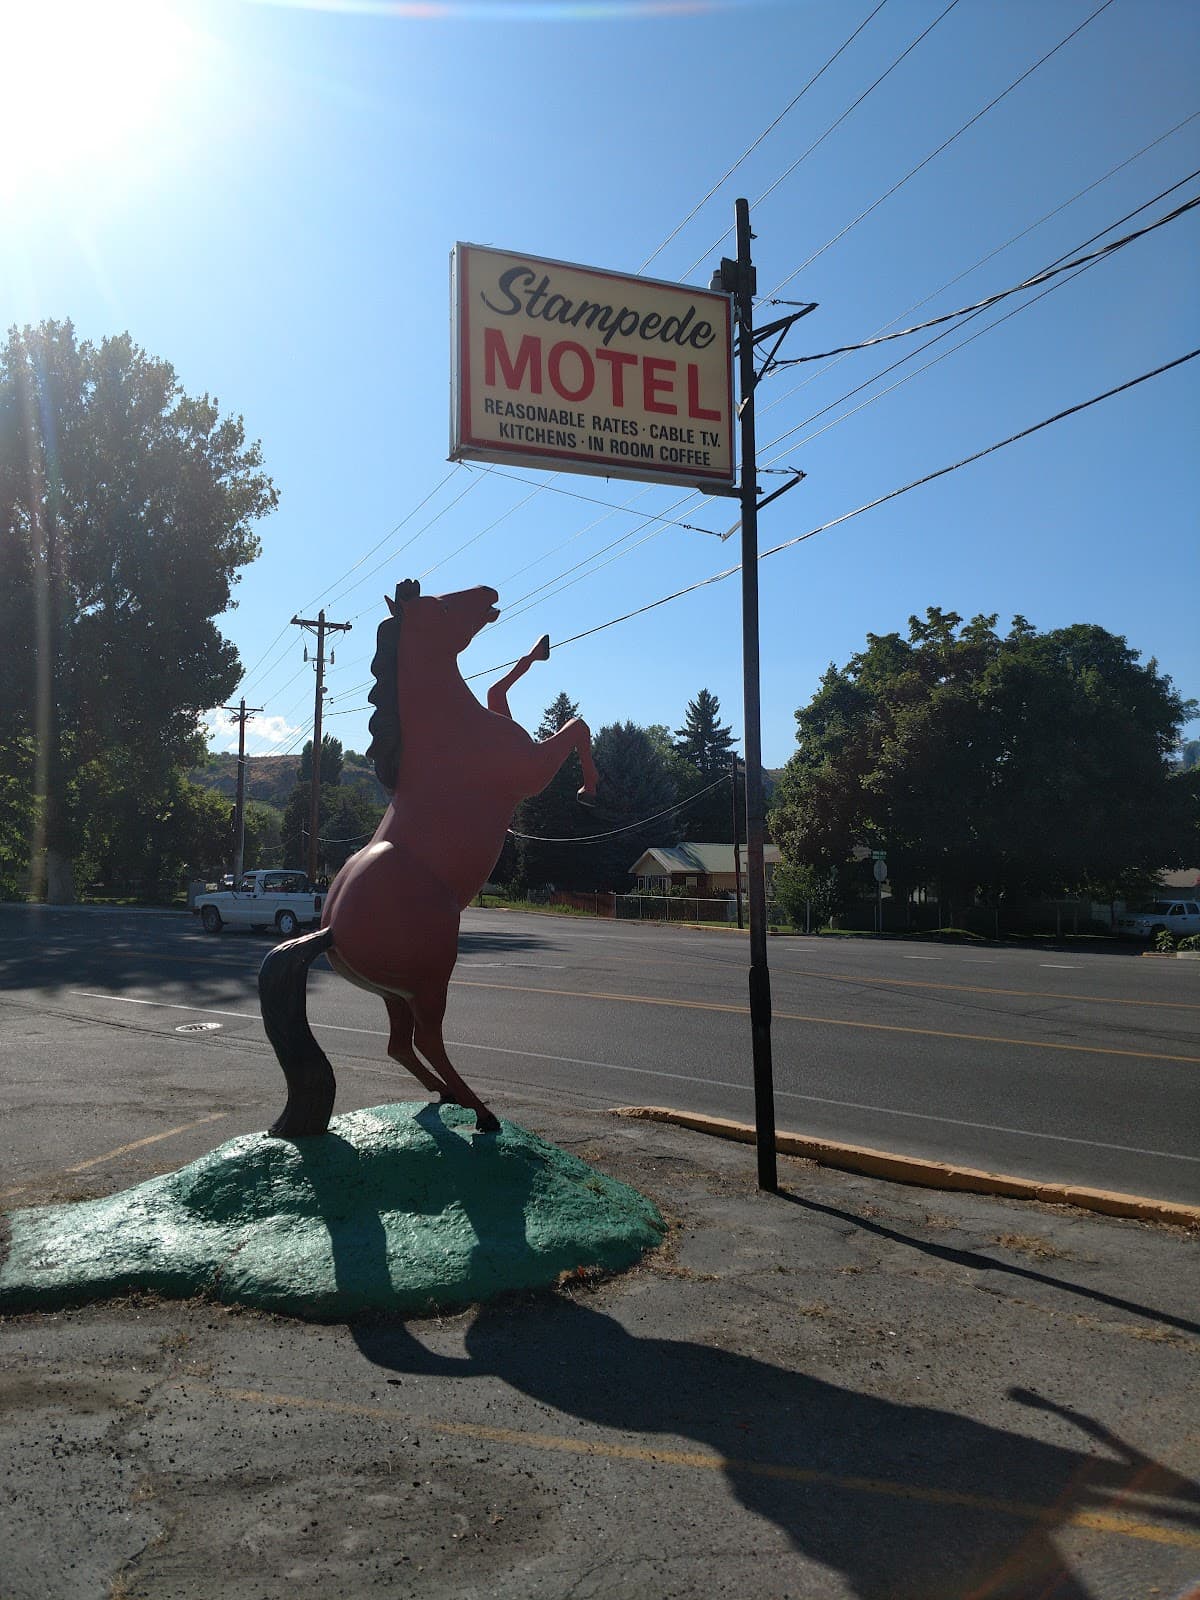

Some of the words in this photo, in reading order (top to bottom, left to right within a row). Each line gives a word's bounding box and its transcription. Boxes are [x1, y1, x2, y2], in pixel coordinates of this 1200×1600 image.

[480, 266, 716, 349] Stampede
[484, 327, 721, 422] MOTEL
[484, 398, 585, 428] REASONABLE
[592, 415, 638, 436] RATES
[650, 424, 695, 444] CABLE
[499, 422, 577, 448] KITCHENS
[588, 435, 604, 452] IN
[610, 438, 654, 459] ROOM
[660, 445, 711, 466] COFFEE
